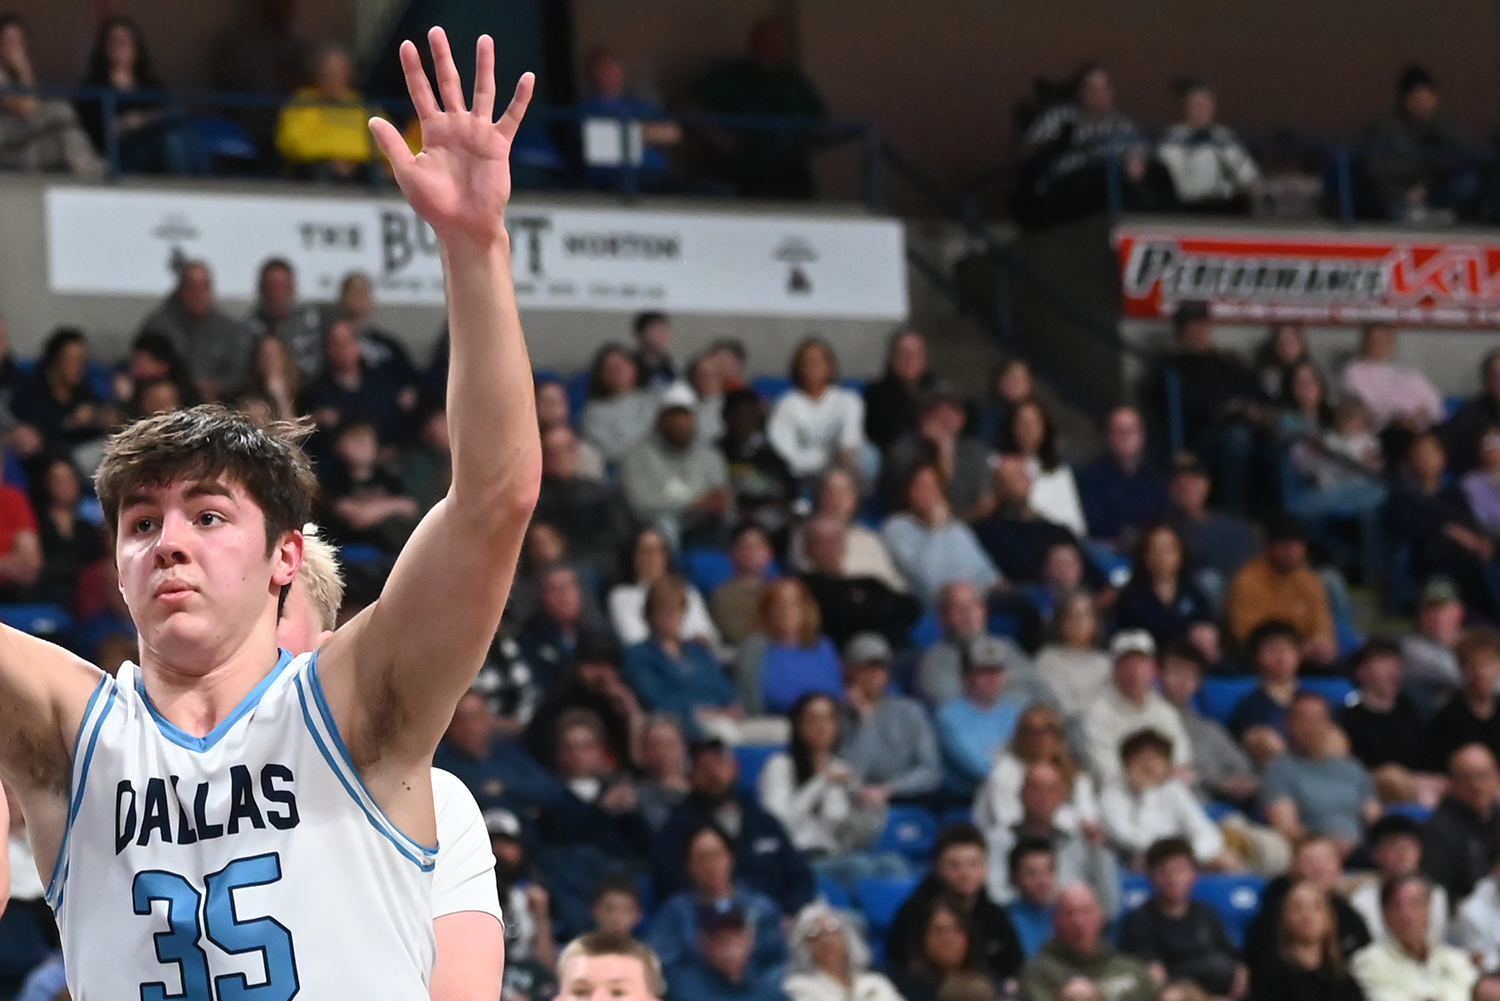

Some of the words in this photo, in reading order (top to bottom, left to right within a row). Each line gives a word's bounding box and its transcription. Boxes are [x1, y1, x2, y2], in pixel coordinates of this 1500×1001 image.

[299, 221, 362, 250] THE
[381, 210, 550, 277] BUT
[115, 763, 301, 856] DALLAS
